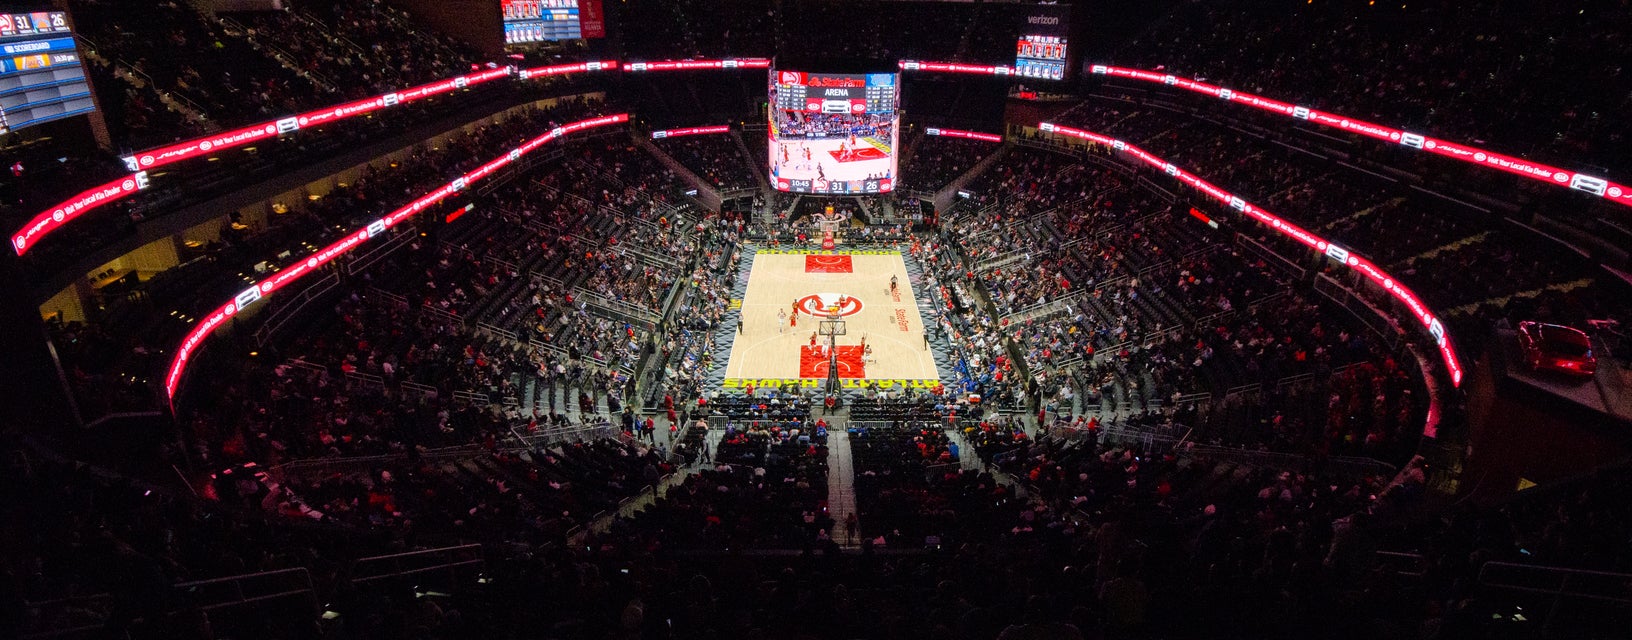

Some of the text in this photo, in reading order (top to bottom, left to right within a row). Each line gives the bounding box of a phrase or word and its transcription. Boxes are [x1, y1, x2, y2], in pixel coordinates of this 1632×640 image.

[16, 15, 30, 30] 31
[51, 14, 65, 26] 26
[1027, 14, 1059, 26] verizon
[14, 42, 50, 52] SCOREBOARD
[822, 78, 866, 88] State Farm
[824, 88, 849, 96] ARENA
[832, 182, 842, 190] 31
[866, 182, 877, 190] 26
[840, 379, 939, 388] ATLANT
